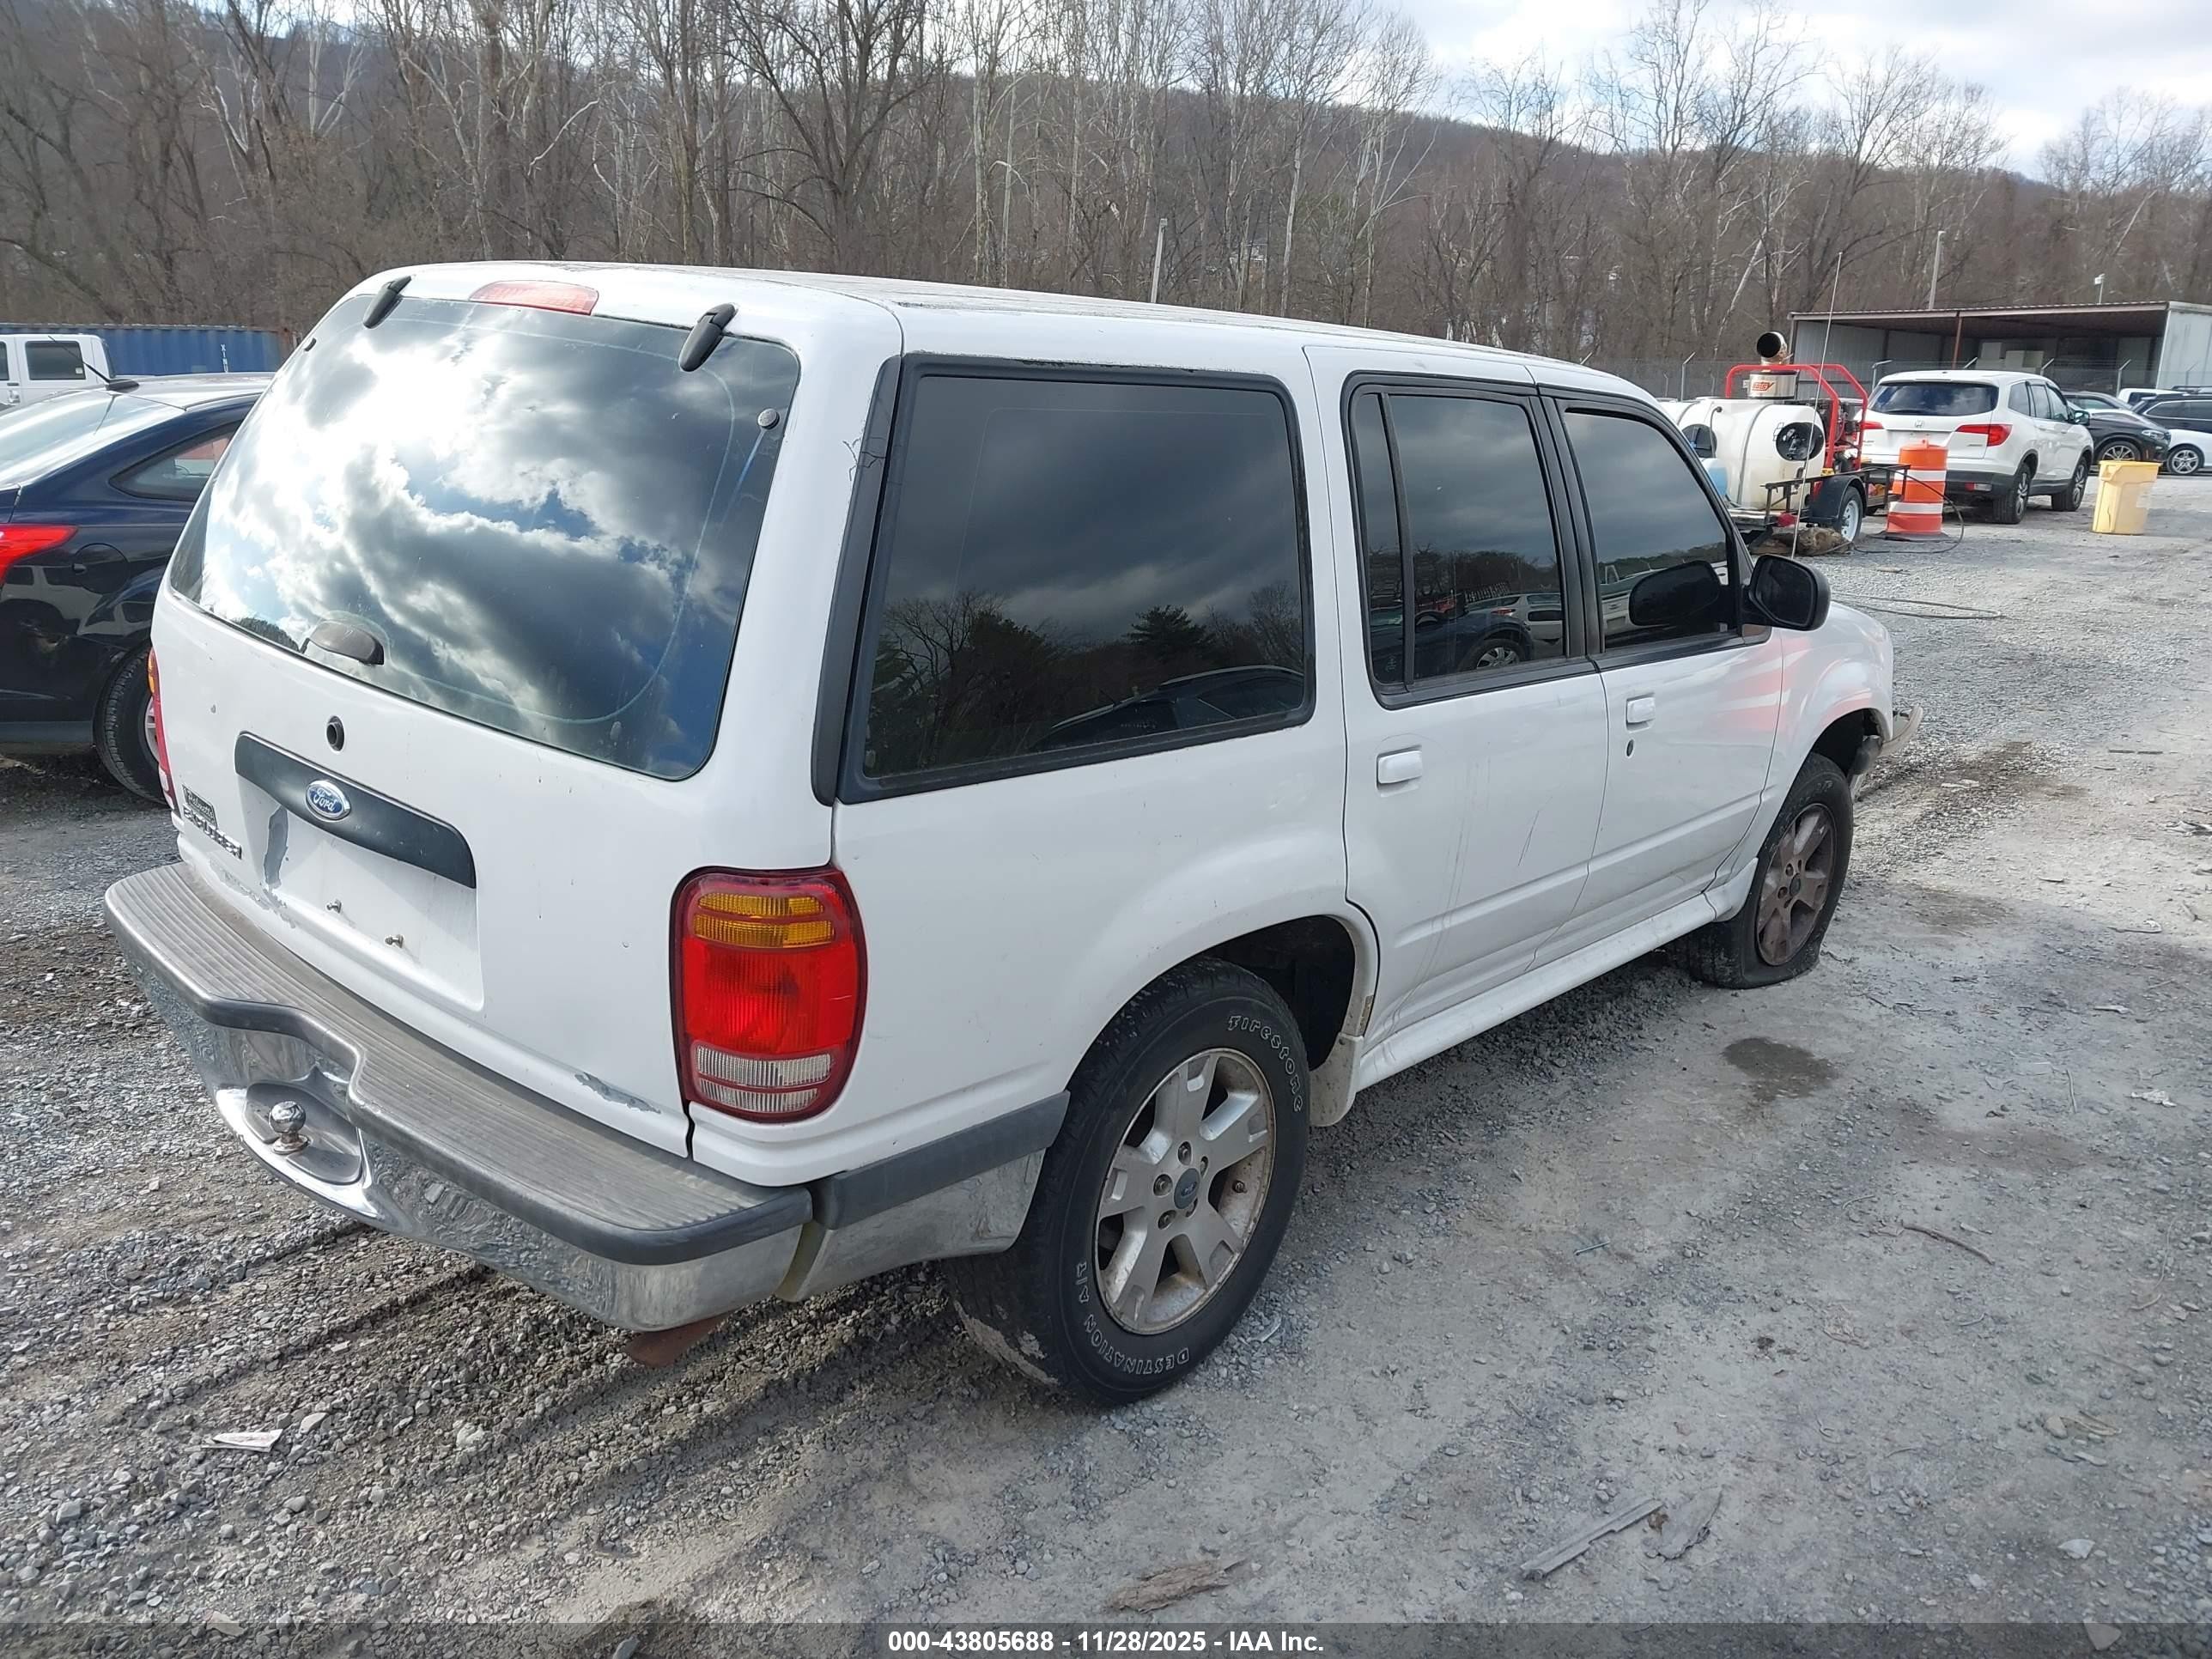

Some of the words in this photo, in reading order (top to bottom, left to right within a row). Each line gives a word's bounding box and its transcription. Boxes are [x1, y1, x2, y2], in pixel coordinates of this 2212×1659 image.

[313, 787, 338, 811] Ford
[1228, 1015, 1304, 1113] Firestone
[1075, 1261, 1090, 1304] A/T
[1084, 1314, 1189, 1375] DESTINATION
